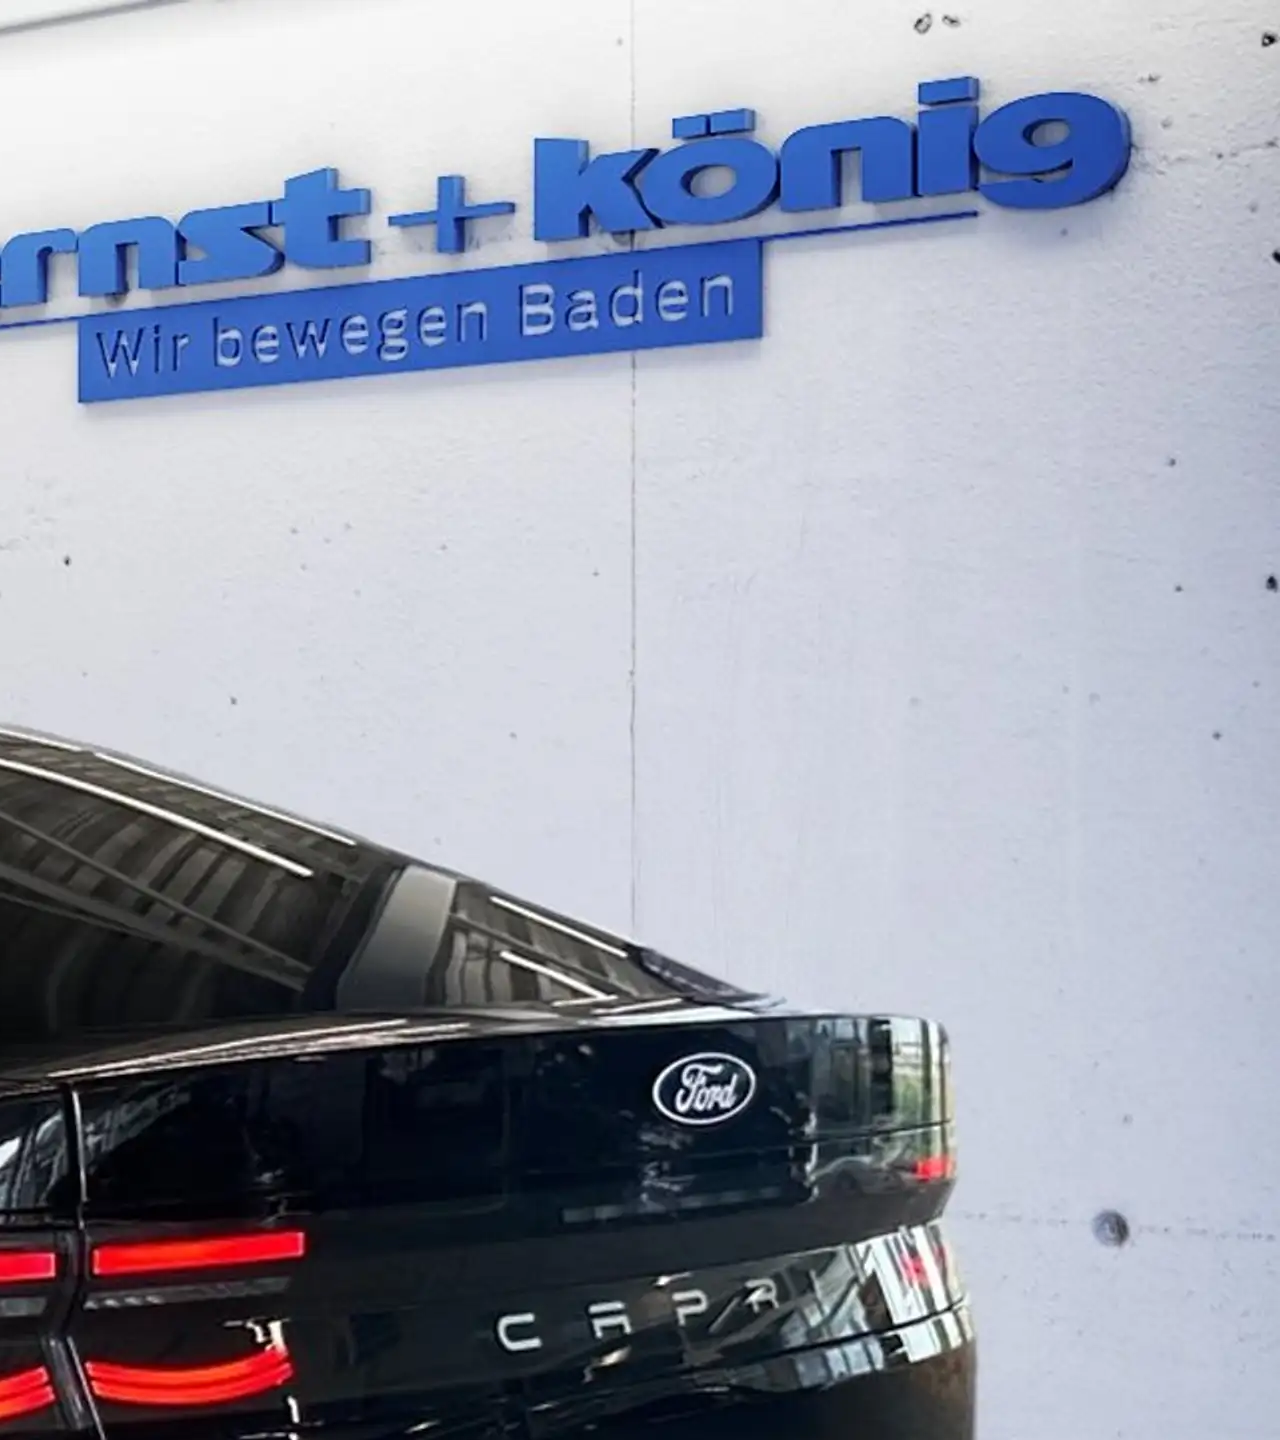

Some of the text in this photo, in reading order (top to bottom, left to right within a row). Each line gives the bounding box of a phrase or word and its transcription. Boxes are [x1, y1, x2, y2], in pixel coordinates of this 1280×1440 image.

[96, 267, 736, 378] Wir bewegen Baden
[676, 1063, 738, 1112] Ford
